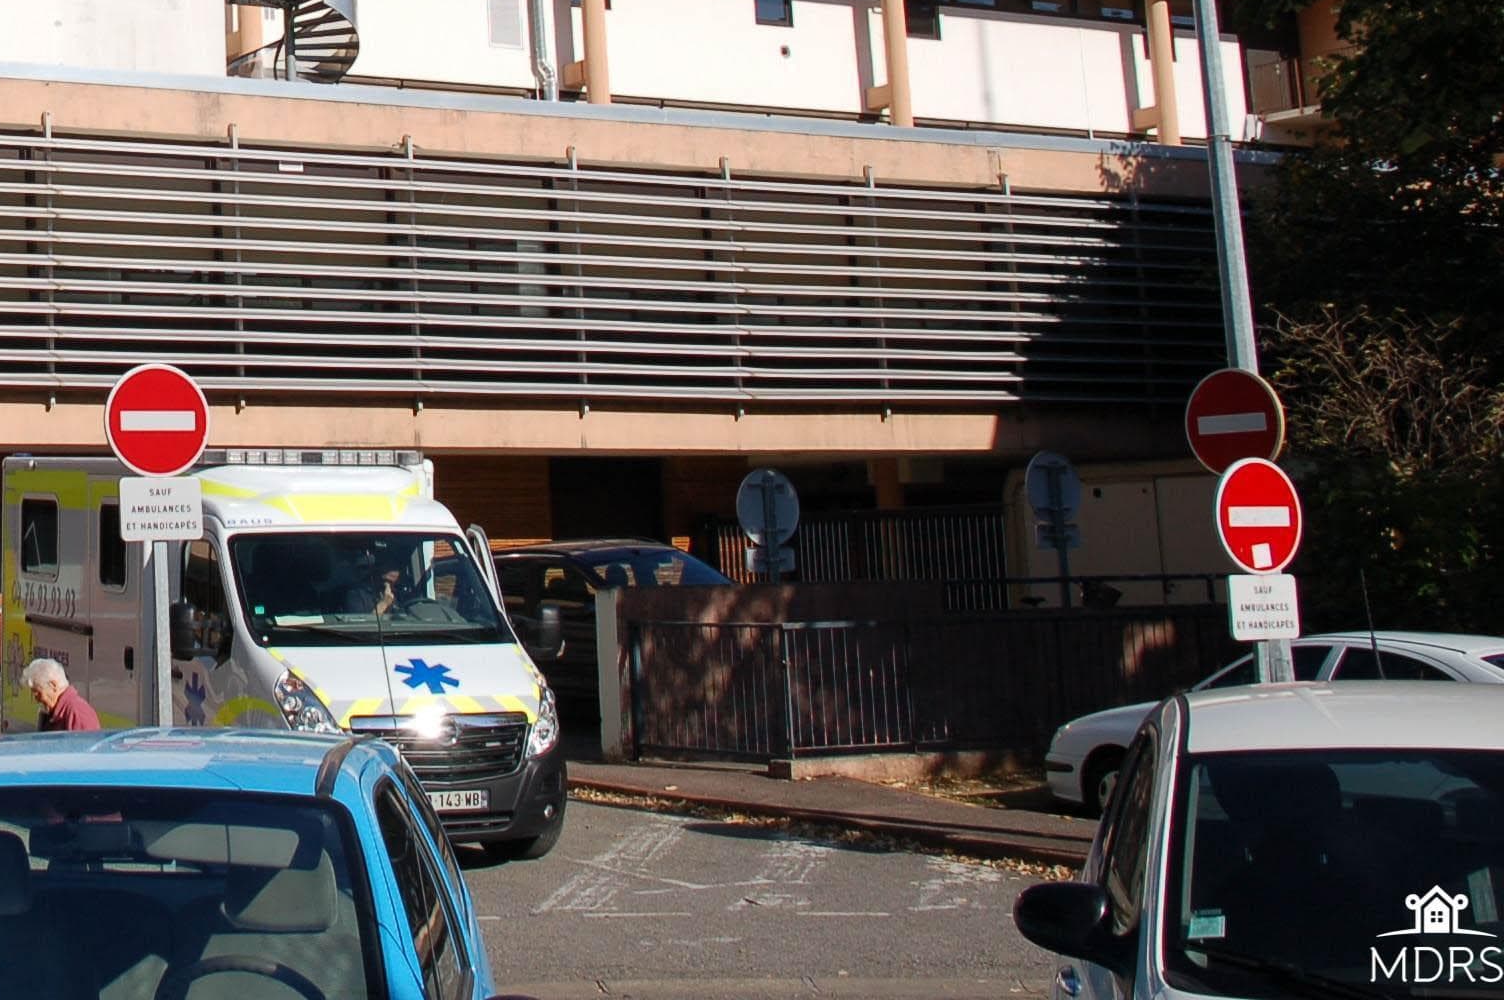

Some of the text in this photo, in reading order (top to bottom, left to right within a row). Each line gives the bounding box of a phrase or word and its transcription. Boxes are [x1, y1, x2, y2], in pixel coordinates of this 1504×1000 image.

[149, 488, 172, 497] SAUF
[131, 504, 192, 513] AMBULANCES
[126, 520, 197, 531] ET HANDICAPÉS
[1253, 585, 1272, 594] SAUF
[25, 582, 35, 609] 76
[38, 583, 48, 614] 93
[51, 585, 61, 616] 93
[65, 587, 76, 619] 93
[1240, 603, 1289, 612] AMBULANCES
[1236, 620, 1246, 630] ET
